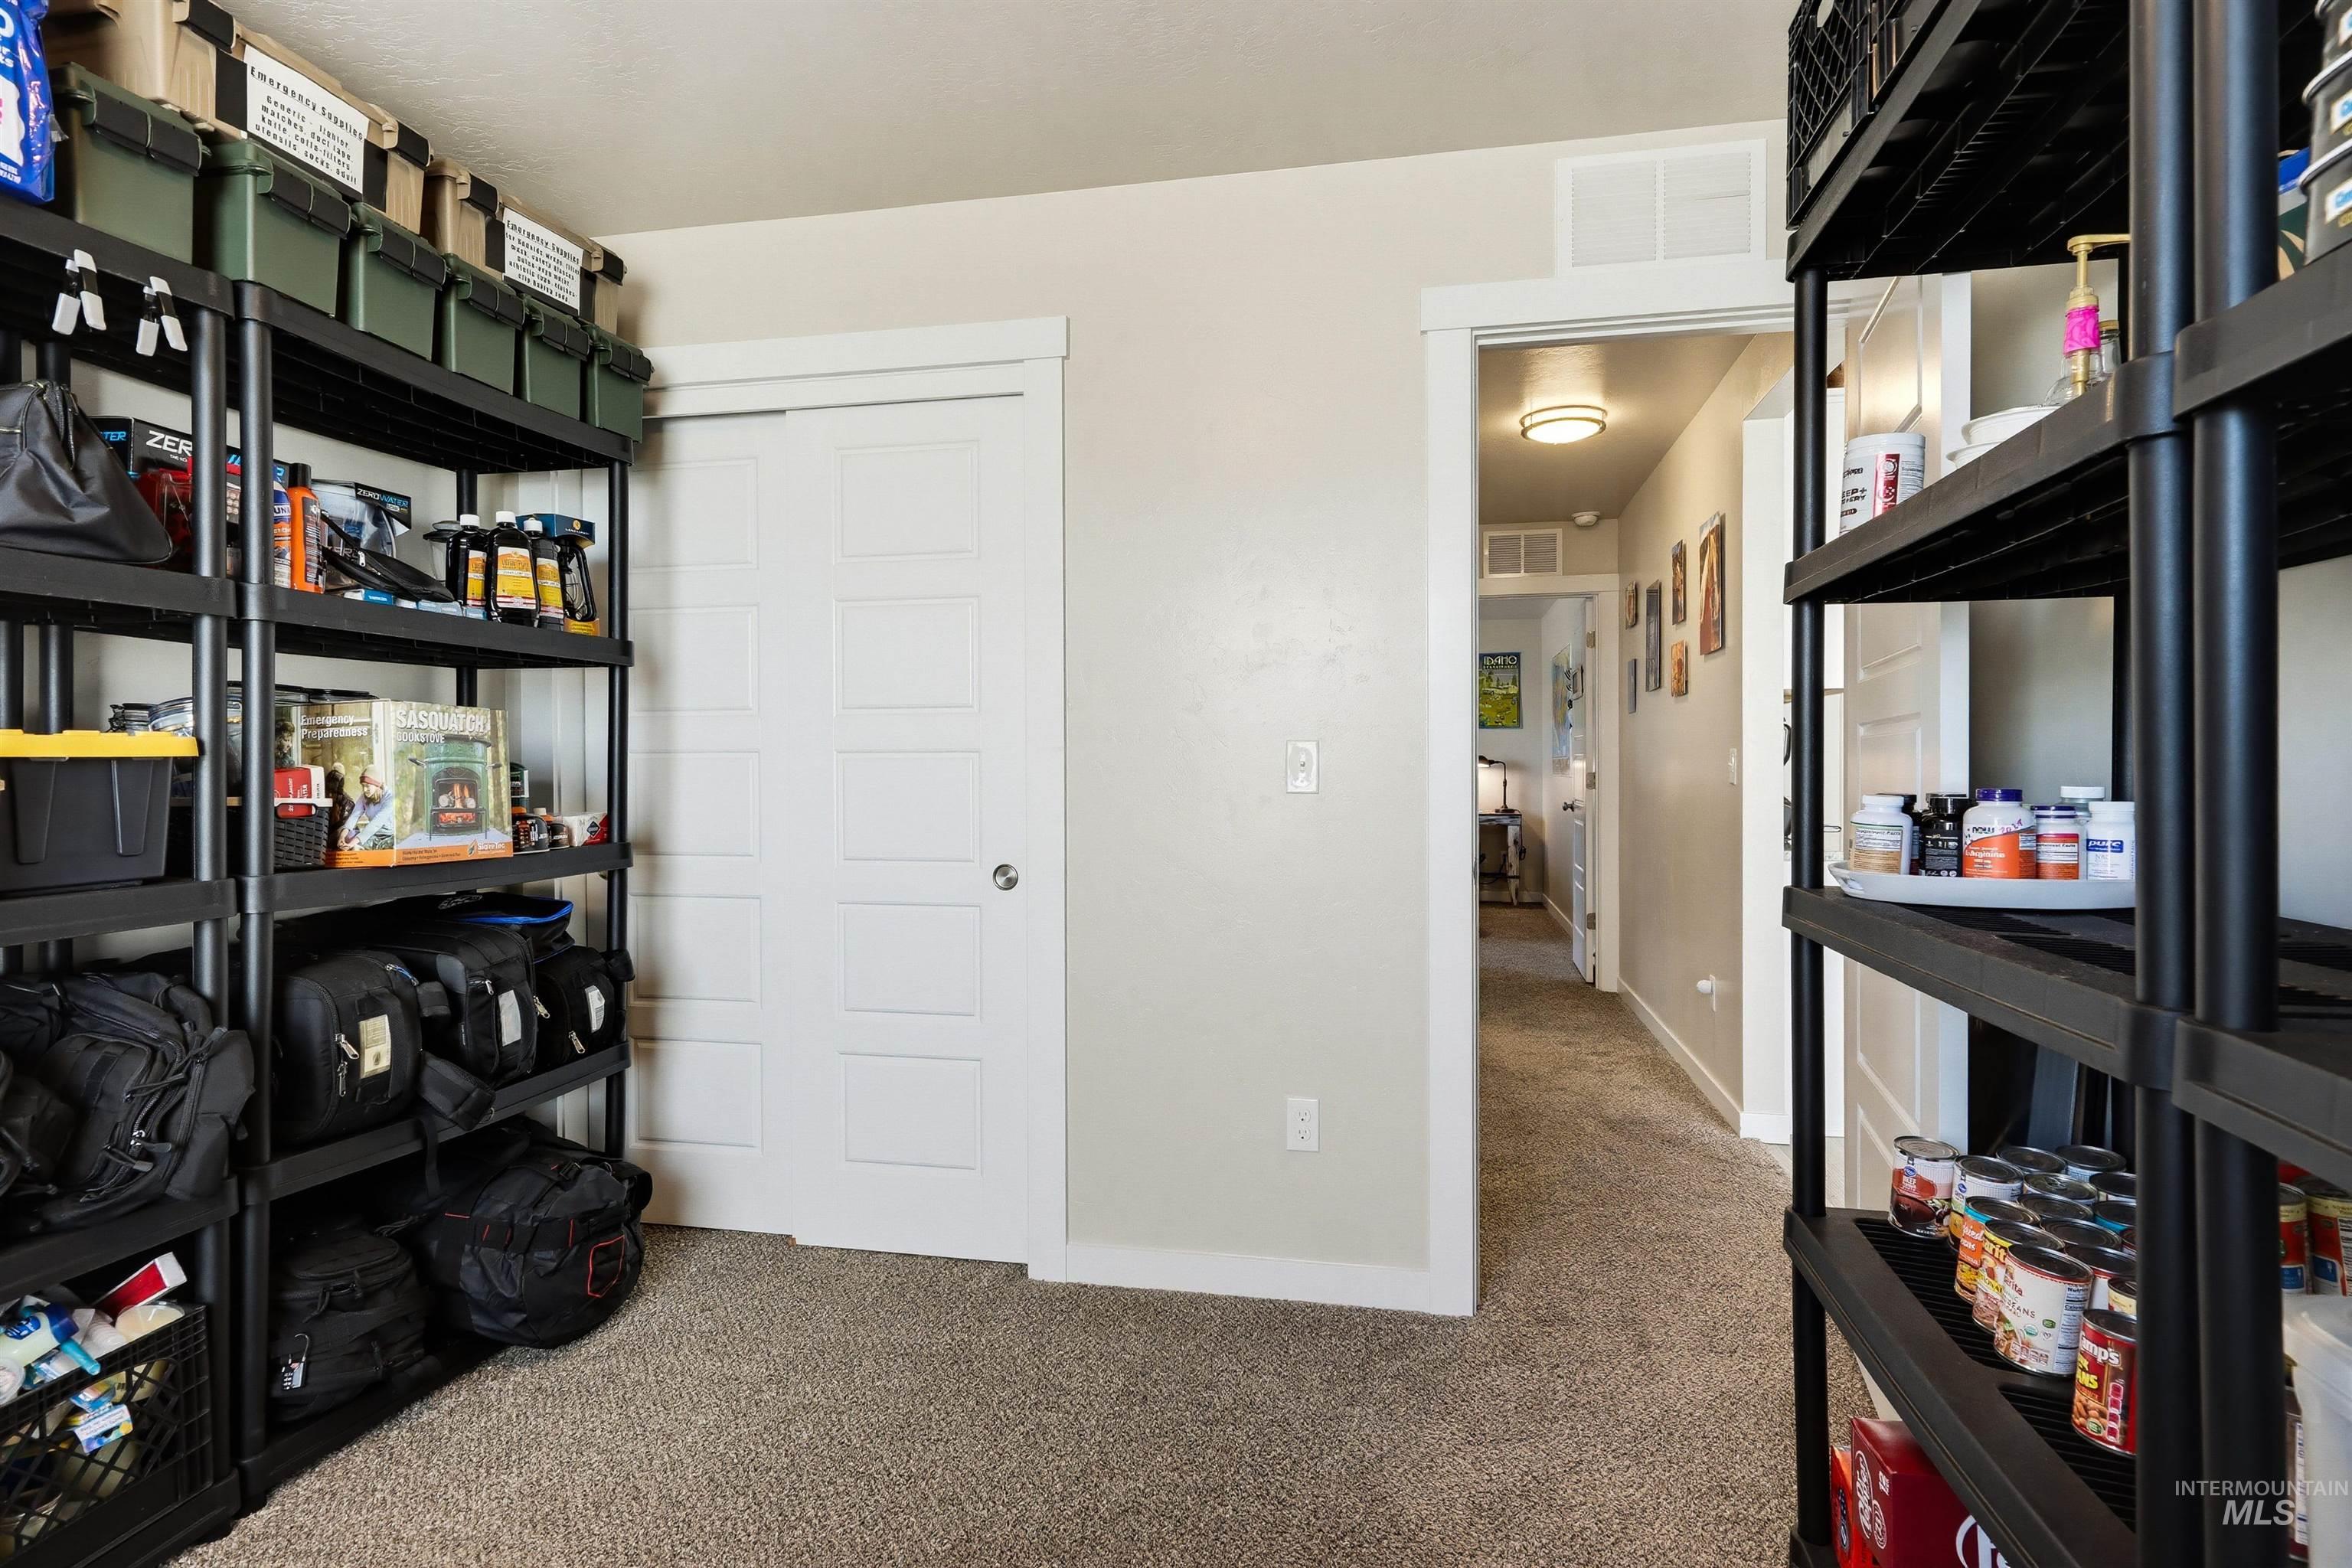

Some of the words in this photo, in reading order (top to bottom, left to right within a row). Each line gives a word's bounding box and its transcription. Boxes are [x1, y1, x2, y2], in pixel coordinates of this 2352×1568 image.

[250, 66, 316, 111] Emergency
[322, 106, 364, 141] Supplies
[266, 95, 306, 122] Generic
[507, 220, 548, 247] Emergency
[552, 243, 579, 264] Supplies
[145, 430, 192, 455] ZER
[1483, 655, 1517, 665] IDAHO
[301, 715, 354, 726] Emergency
[395, 708, 486, 733] SASQUATCH
[301, 726, 368, 739] Preparedness
[397, 732, 446, 743] COOKSTOVE
[1984, 1237, 2007, 1263] arit
[2004, 1276, 2023, 1296] arita
[2077, 1370, 2099, 1390] ANS
